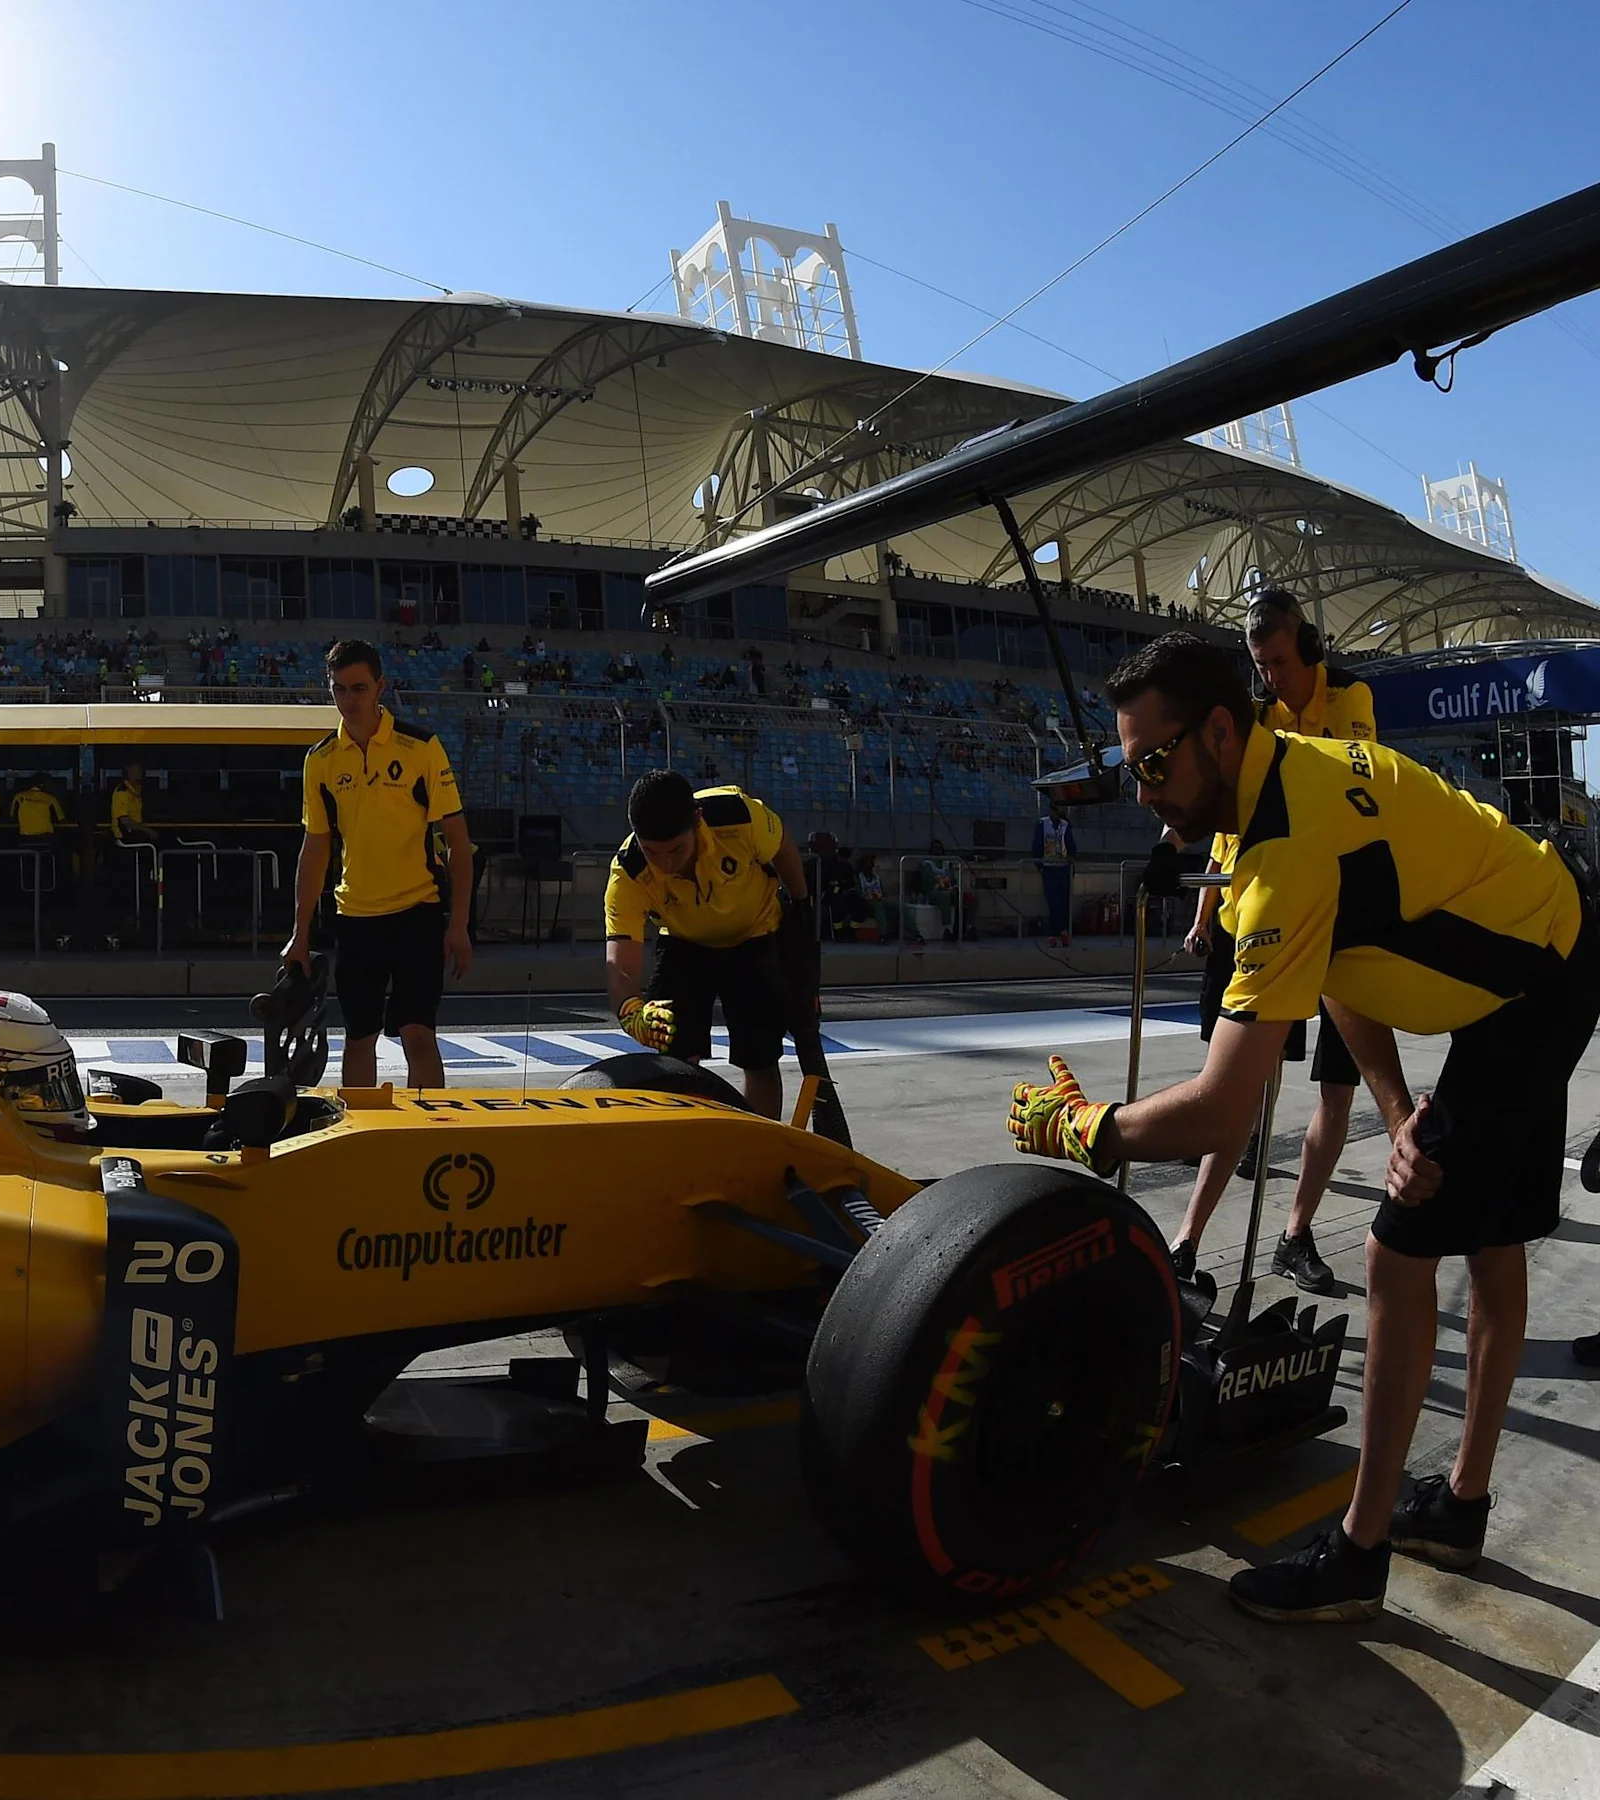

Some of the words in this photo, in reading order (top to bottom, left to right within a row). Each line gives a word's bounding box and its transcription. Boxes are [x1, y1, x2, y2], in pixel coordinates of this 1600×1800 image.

[1428, 683, 1480, 719] Gulf
[1486, 680, 1521, 715] Air
[124, 1240, 225, 1284] 20
[337, 1217, 567, 1281] Computacenter
[991, 1217, 1116, 1311] PIRELLI
[1217, 1344, 1336, 1405] RENAULT
[123, 1373, 170, 1528] JACK
